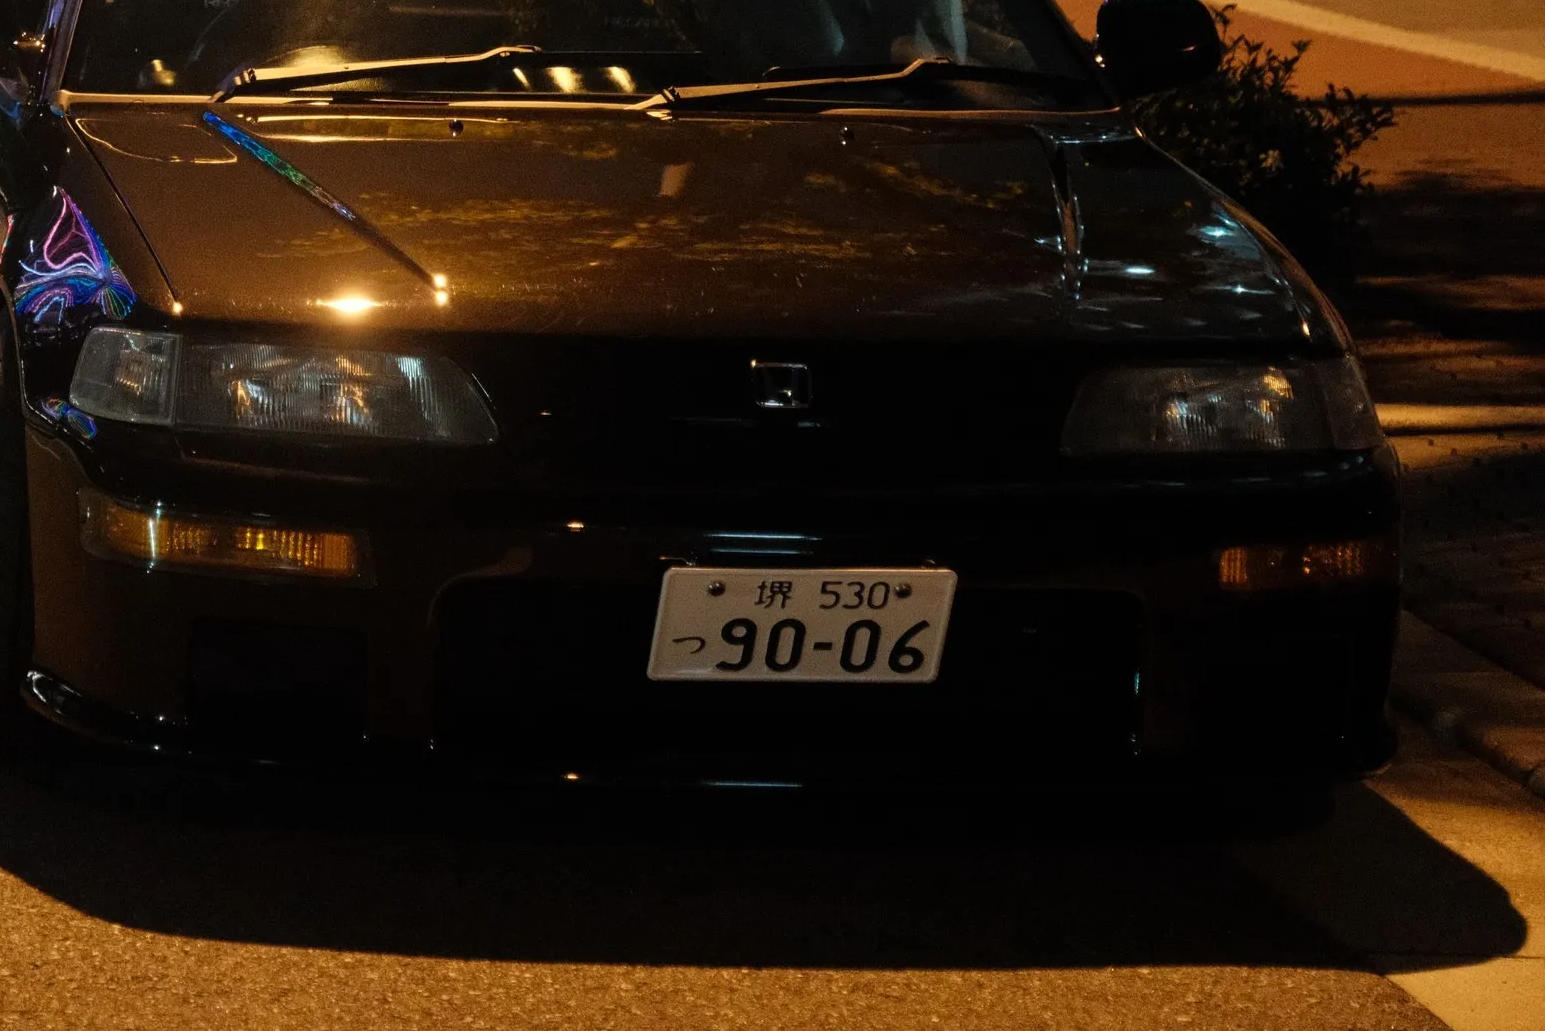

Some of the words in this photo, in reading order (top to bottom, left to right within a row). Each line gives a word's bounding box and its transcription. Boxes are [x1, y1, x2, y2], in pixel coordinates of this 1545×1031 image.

[754, 580, 793, 609] 堺
[818, 580, 891, 610] 530
[672, 636, 707, 655] つ
[715, 617, 931, 674] 90-06
